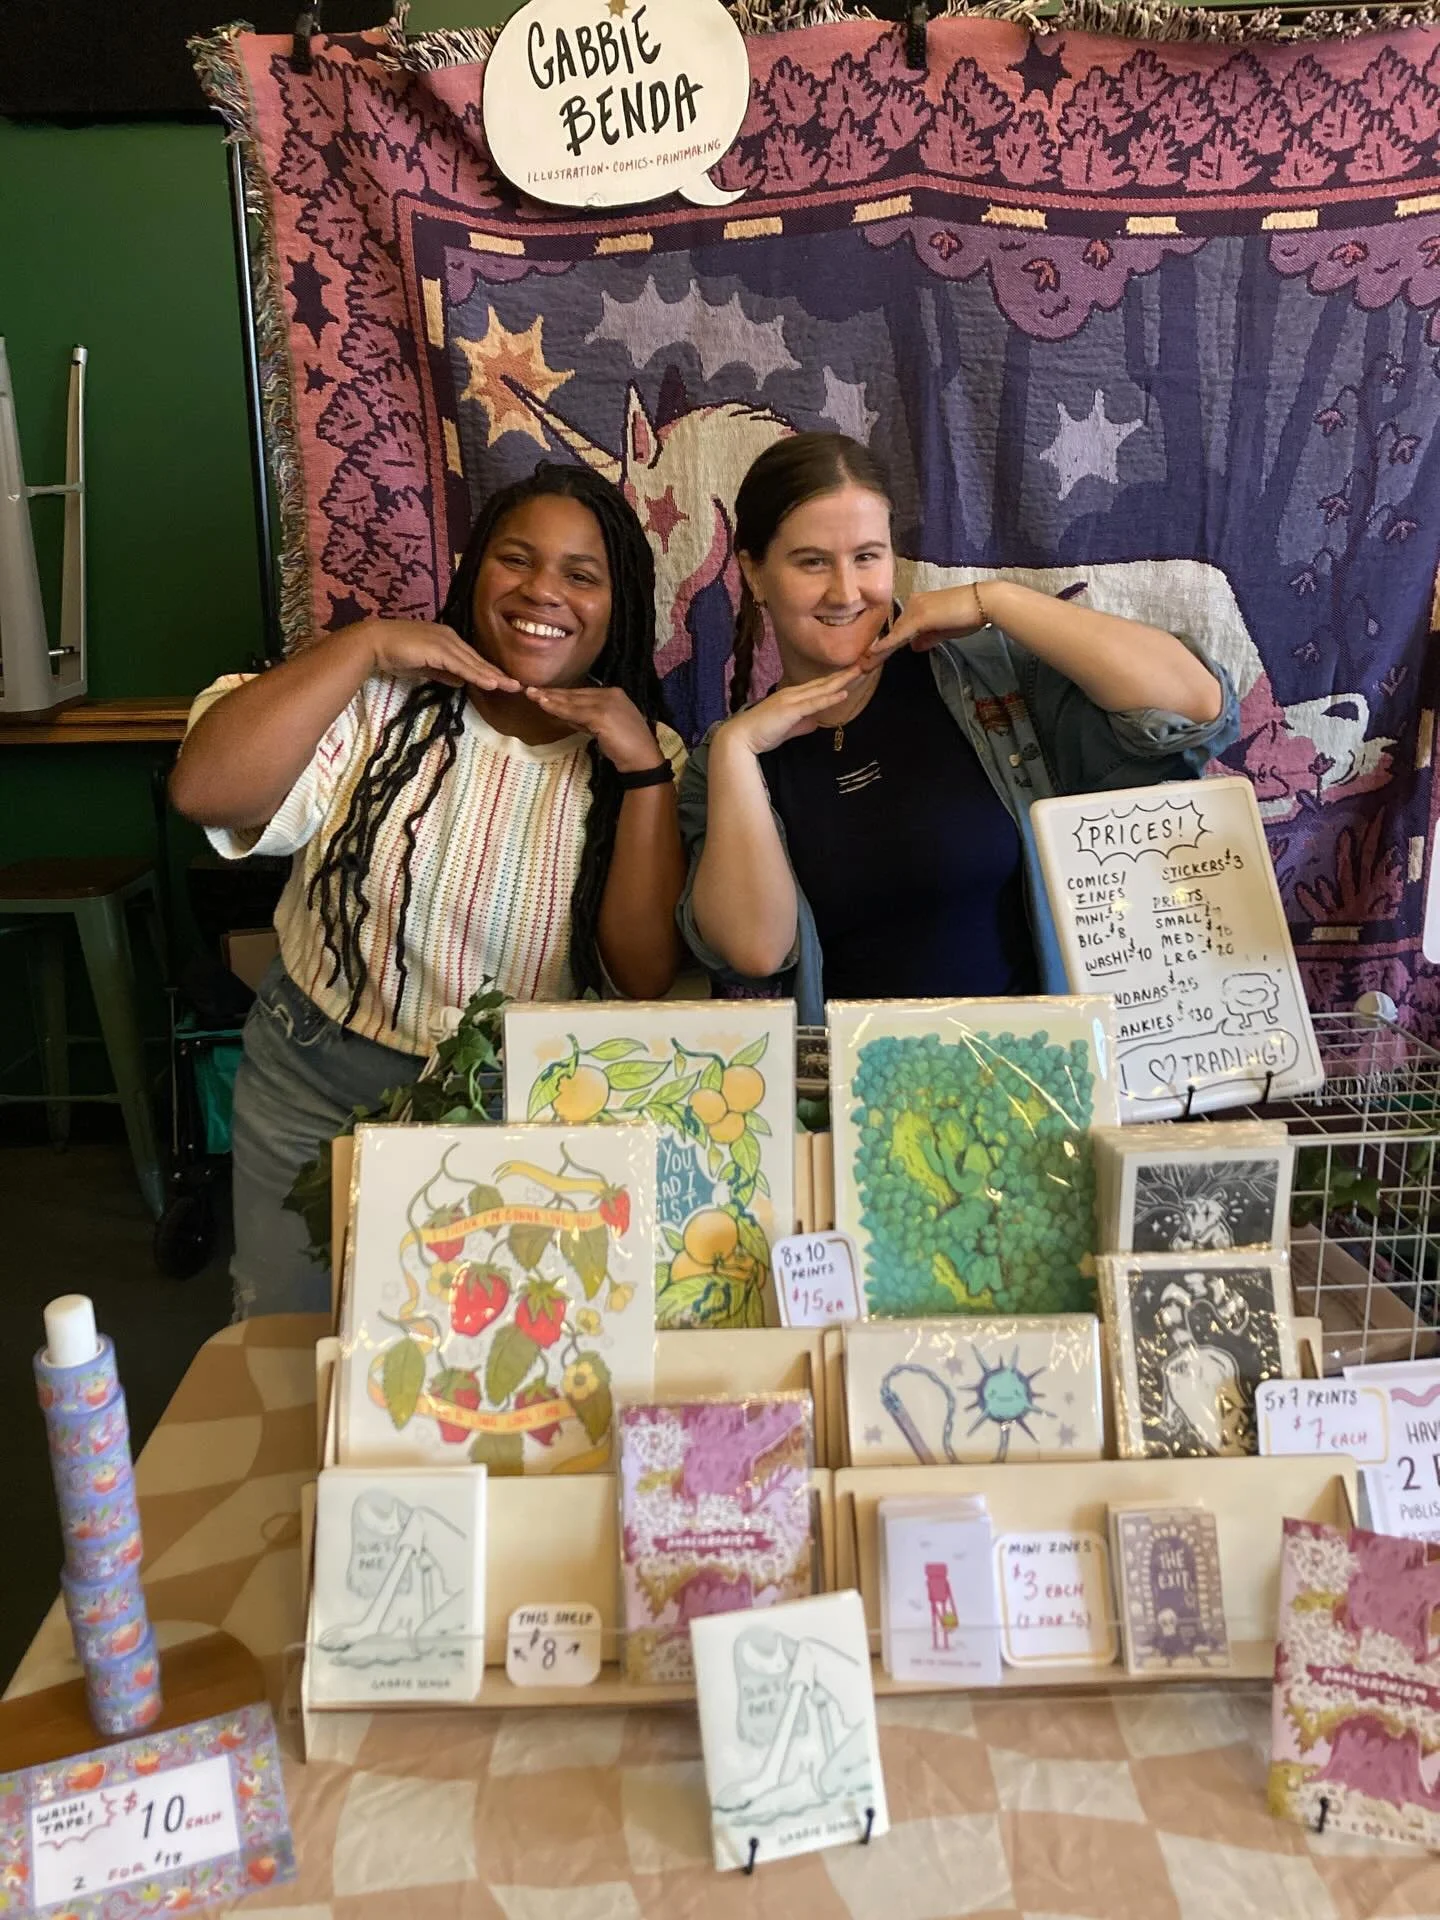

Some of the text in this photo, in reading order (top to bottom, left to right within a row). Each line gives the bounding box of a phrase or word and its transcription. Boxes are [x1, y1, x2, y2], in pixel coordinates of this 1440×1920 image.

[528, 5, 662, 90] GABBIE
[559, 73, 703, 157] BENDA
[527, 138, 722, 184] ILLUSTRATION COMICS PRINTMAKING
[1088, 816, 1184, 849] PRICES!
[1067, 871, 1126, 891] COMICS/
[1076, 887, 1126, 905] ZINES
[1151, 888, 1204, 909] PRITS
[1155, 912, 1202, 930] SMALL
[1181, 1038, 1286, 1078] TRADING!
[661, 1141, 692, 1176] YOU
[1307, 1388, 1358, 1412] PRINTS
[1331, 1430, 1368, 1449] EACH
[1397, 1456, 1422, 1491] 2
[1159, 1548, 1185, 1570] THE
